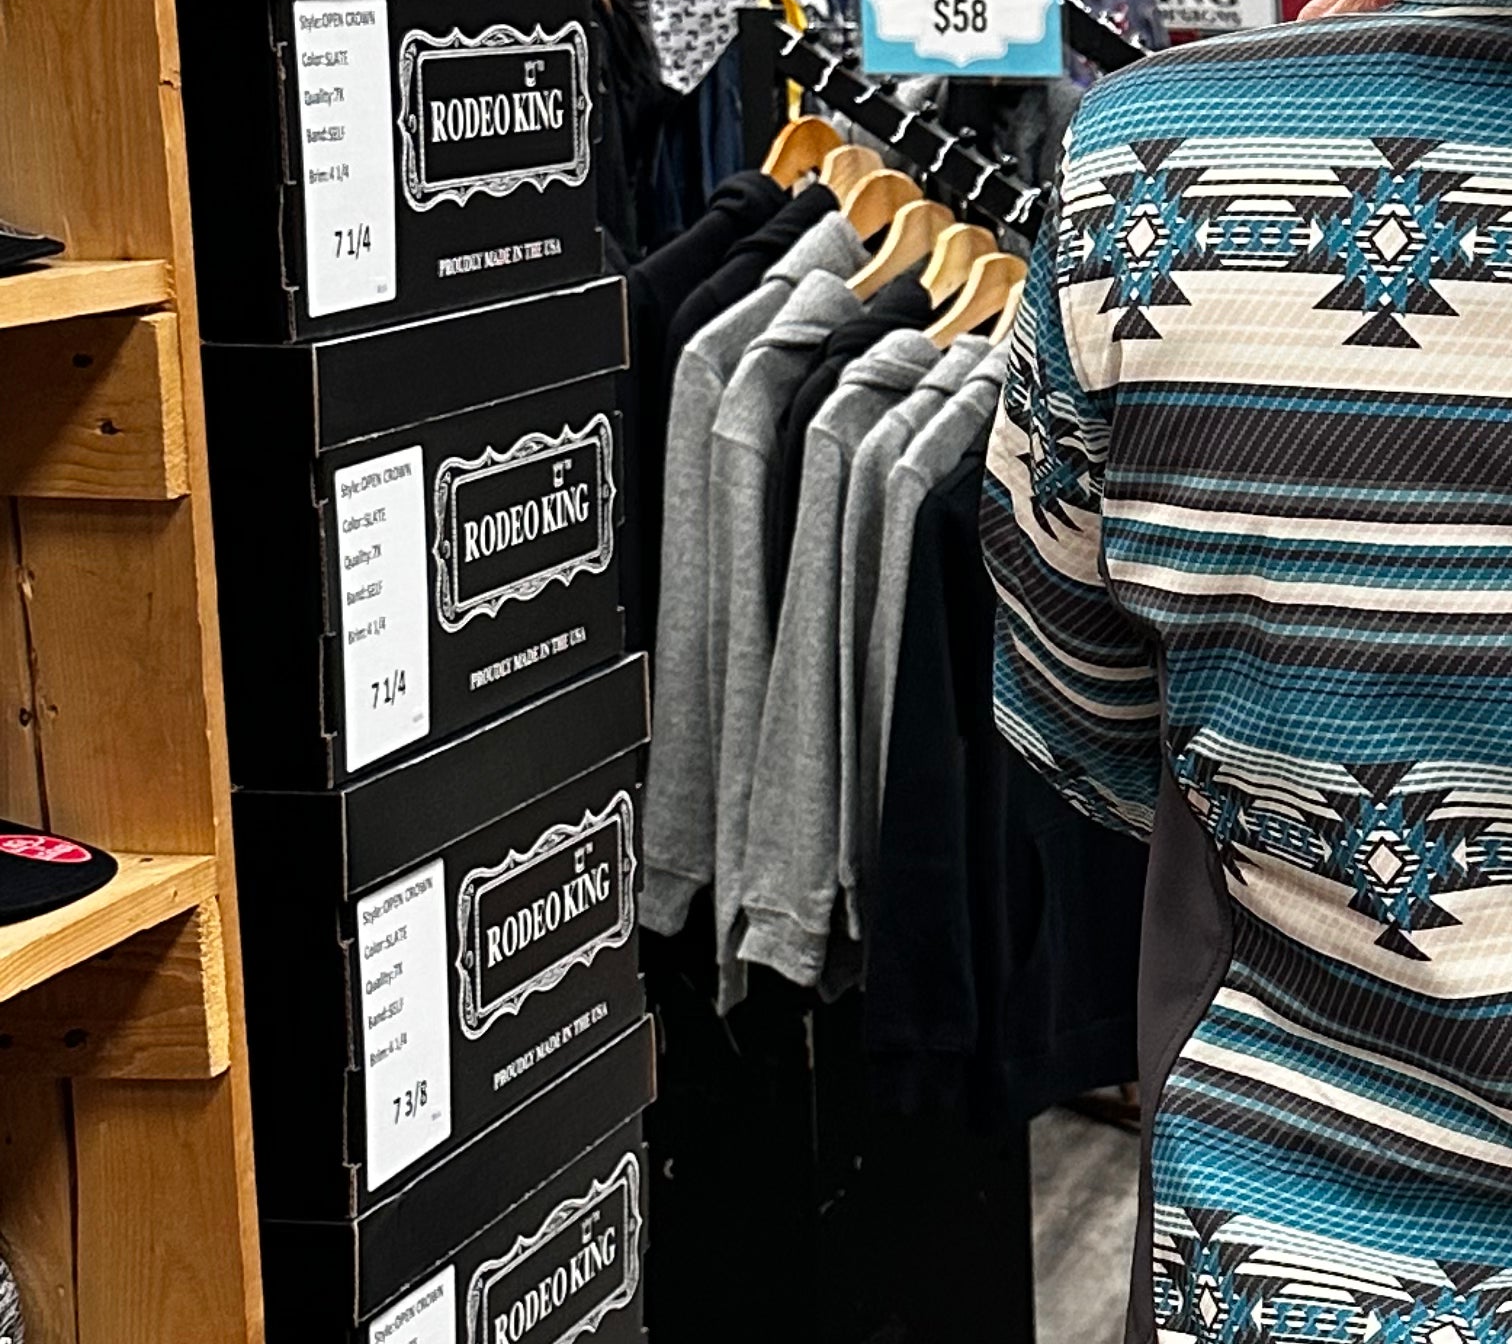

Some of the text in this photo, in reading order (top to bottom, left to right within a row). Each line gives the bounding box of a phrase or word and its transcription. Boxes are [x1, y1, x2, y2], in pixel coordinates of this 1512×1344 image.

[430, 89, 564, 143] RODEO KING
[334, 222, 371, 260] 7 1/4
[464, 483, 589, 562] RODEO KING
[371, 669, 406, 709] 7 1/4
[486, 862, 611, 969] RODEO KING
[393, 1079, 427, 1125] 7 3/8
[568, 1226, 616, 1295] KING
